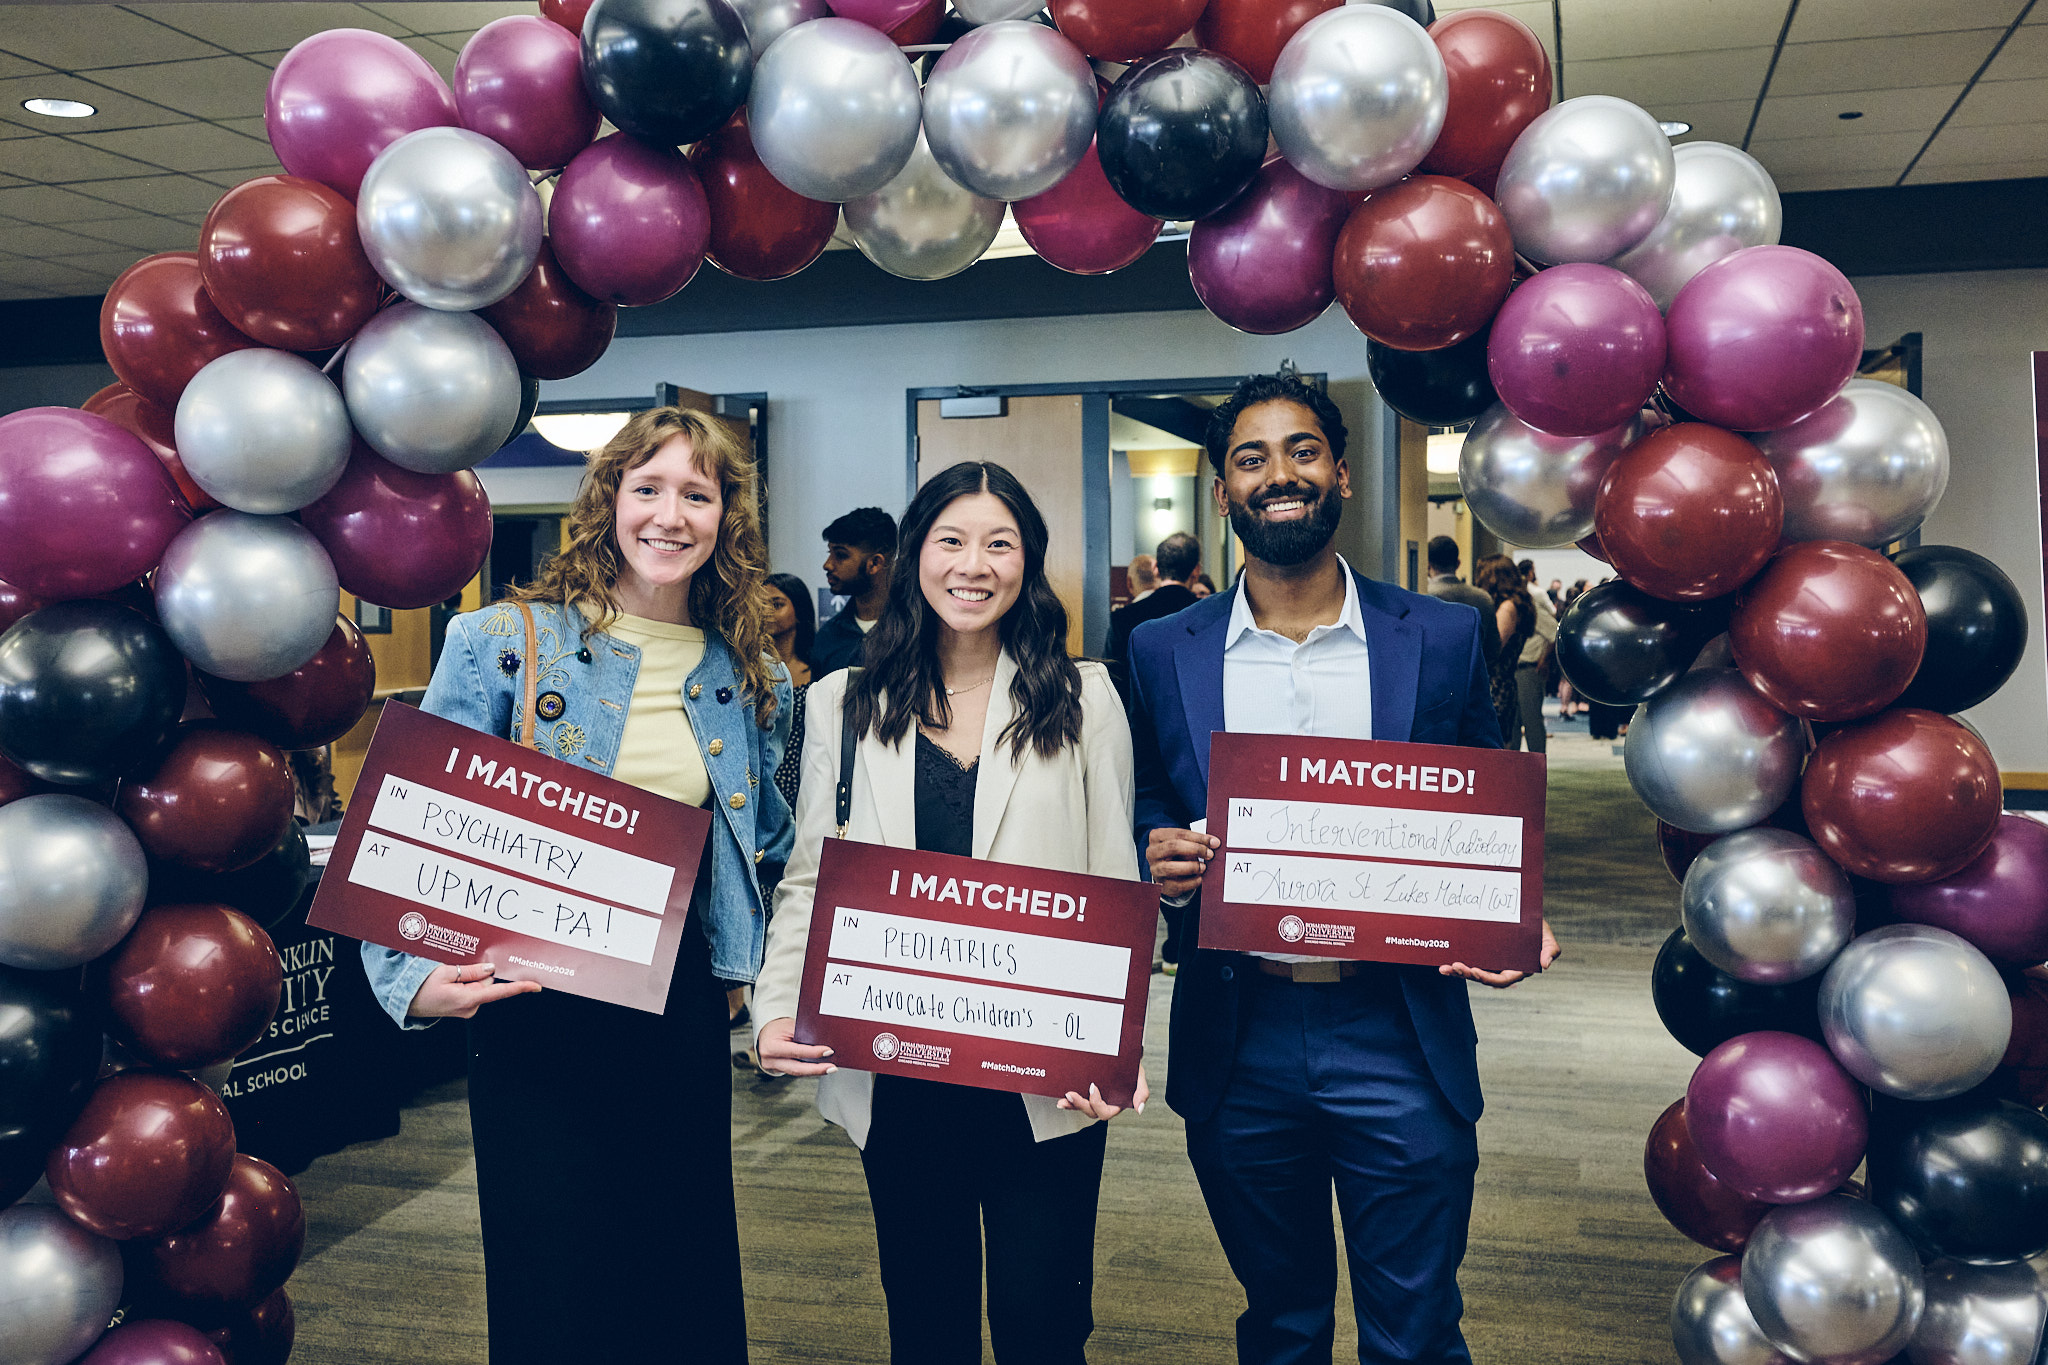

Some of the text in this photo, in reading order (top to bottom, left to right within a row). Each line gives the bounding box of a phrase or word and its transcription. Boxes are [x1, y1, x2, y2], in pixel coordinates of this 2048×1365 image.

[1280, 757, 1476, 795] I MATCHED!
[390, 785, 409, 801] IN
[445, 747, 641, 835] I MATCHED!
[1238, 806, 1253, 818] IN
[367, 843, 391, 858] AT
[422, 802, 583, 880] PSYCHIATRY
[1441, 819, 1518, 866] Radiology
[1233, 862, 1252, 874] AT
[889, 869, 1087, 922] I MATCHED!
[1252, 868, 1338, 902] Aurora
[1384, 874, 1429, 904] Lukes
[1434, 880, 1486, 910] Medical
[843, 916, 859, 929] IN
[1305, 927, 1355, 937] UNIVERSITY
[427, 927, 479, 949] UNIVERSITY
[1385, 936, 1450, 949] #MatchDay2026
[278, 937, 335, 973] NKLIN
[884, 927, 1018, 975] PEDIATRICS
[508, 955, 575, 976] #MatchDay2026
[832, 974, 852, 985] AT
[862, 985, 945, 1020] Advocate
[953, 996, 1033, 1028] Children's
[269, 1005, 330, 1038] SCIENCE
[900, 1045, 951, 1058] UNIVERSITY
[247, 1062, 308, 1093] SCHOOL
[981, 1061, 1046, 1077] #MatchDay2026
